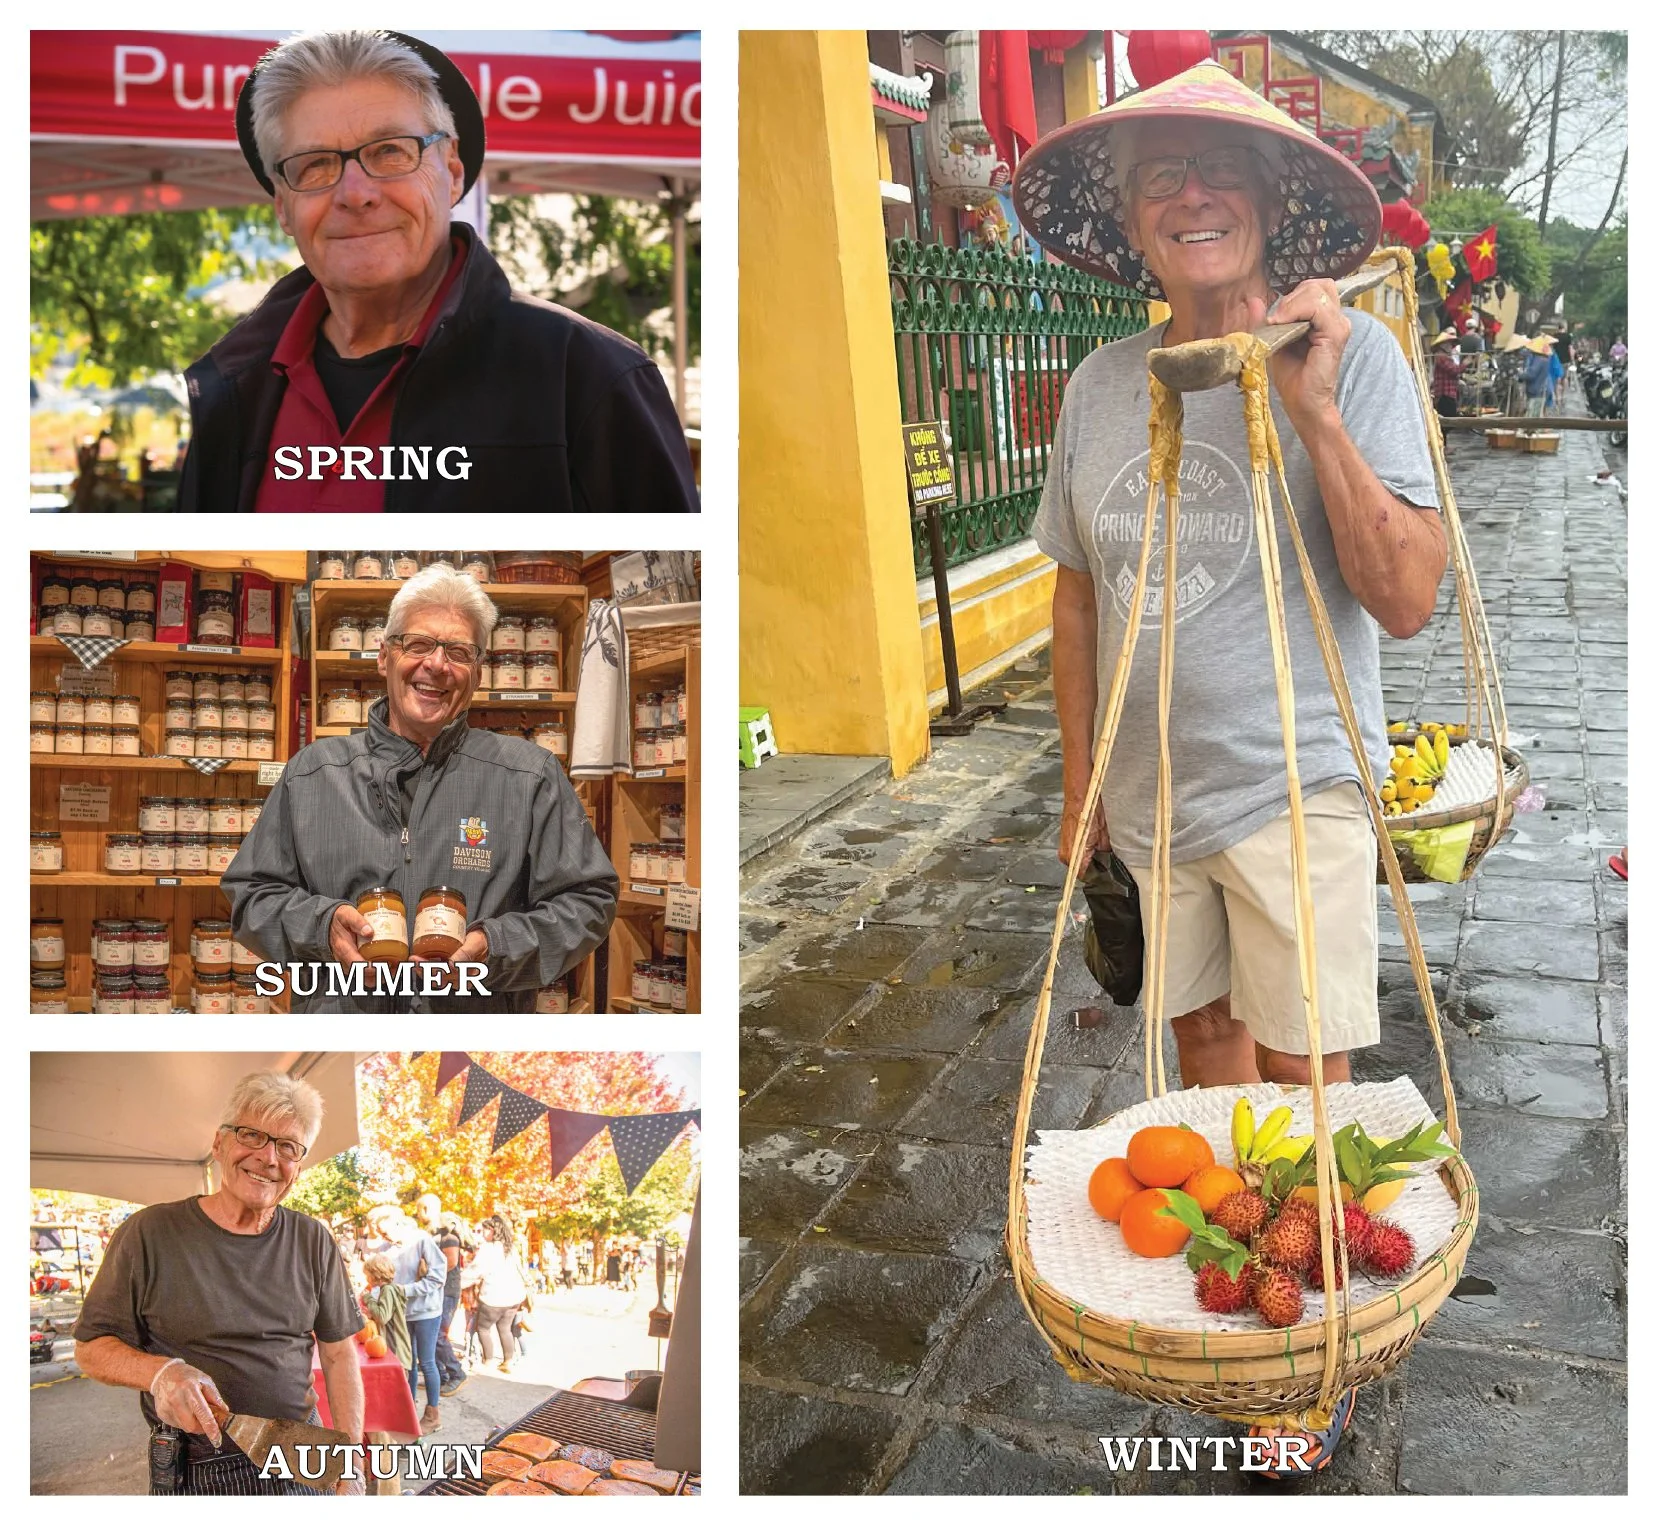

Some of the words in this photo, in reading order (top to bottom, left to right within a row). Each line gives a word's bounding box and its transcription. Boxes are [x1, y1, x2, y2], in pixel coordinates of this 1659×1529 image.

[114, 44, 251, 111] Pur
[568, 67, 701, 127] Juic
[909, 428, 937, 447] KHÔNG
[928, 449, 941, 464] XE
[1125, 470, 1149, 497] EA
[1178, 459, 1226, 497] COAST
[922, 485, 943, 499] PARKING
[942, 482, 953, 495] HERE
[1098, 513, 1162, 543] PRINCE
[1177, 513, 1244, 543] DWARD
[1120, 575, 1156, 613] SIE
[452, 856, 491, 868] ORCHARDS
[453, 846, 492, 859] DAVISON
